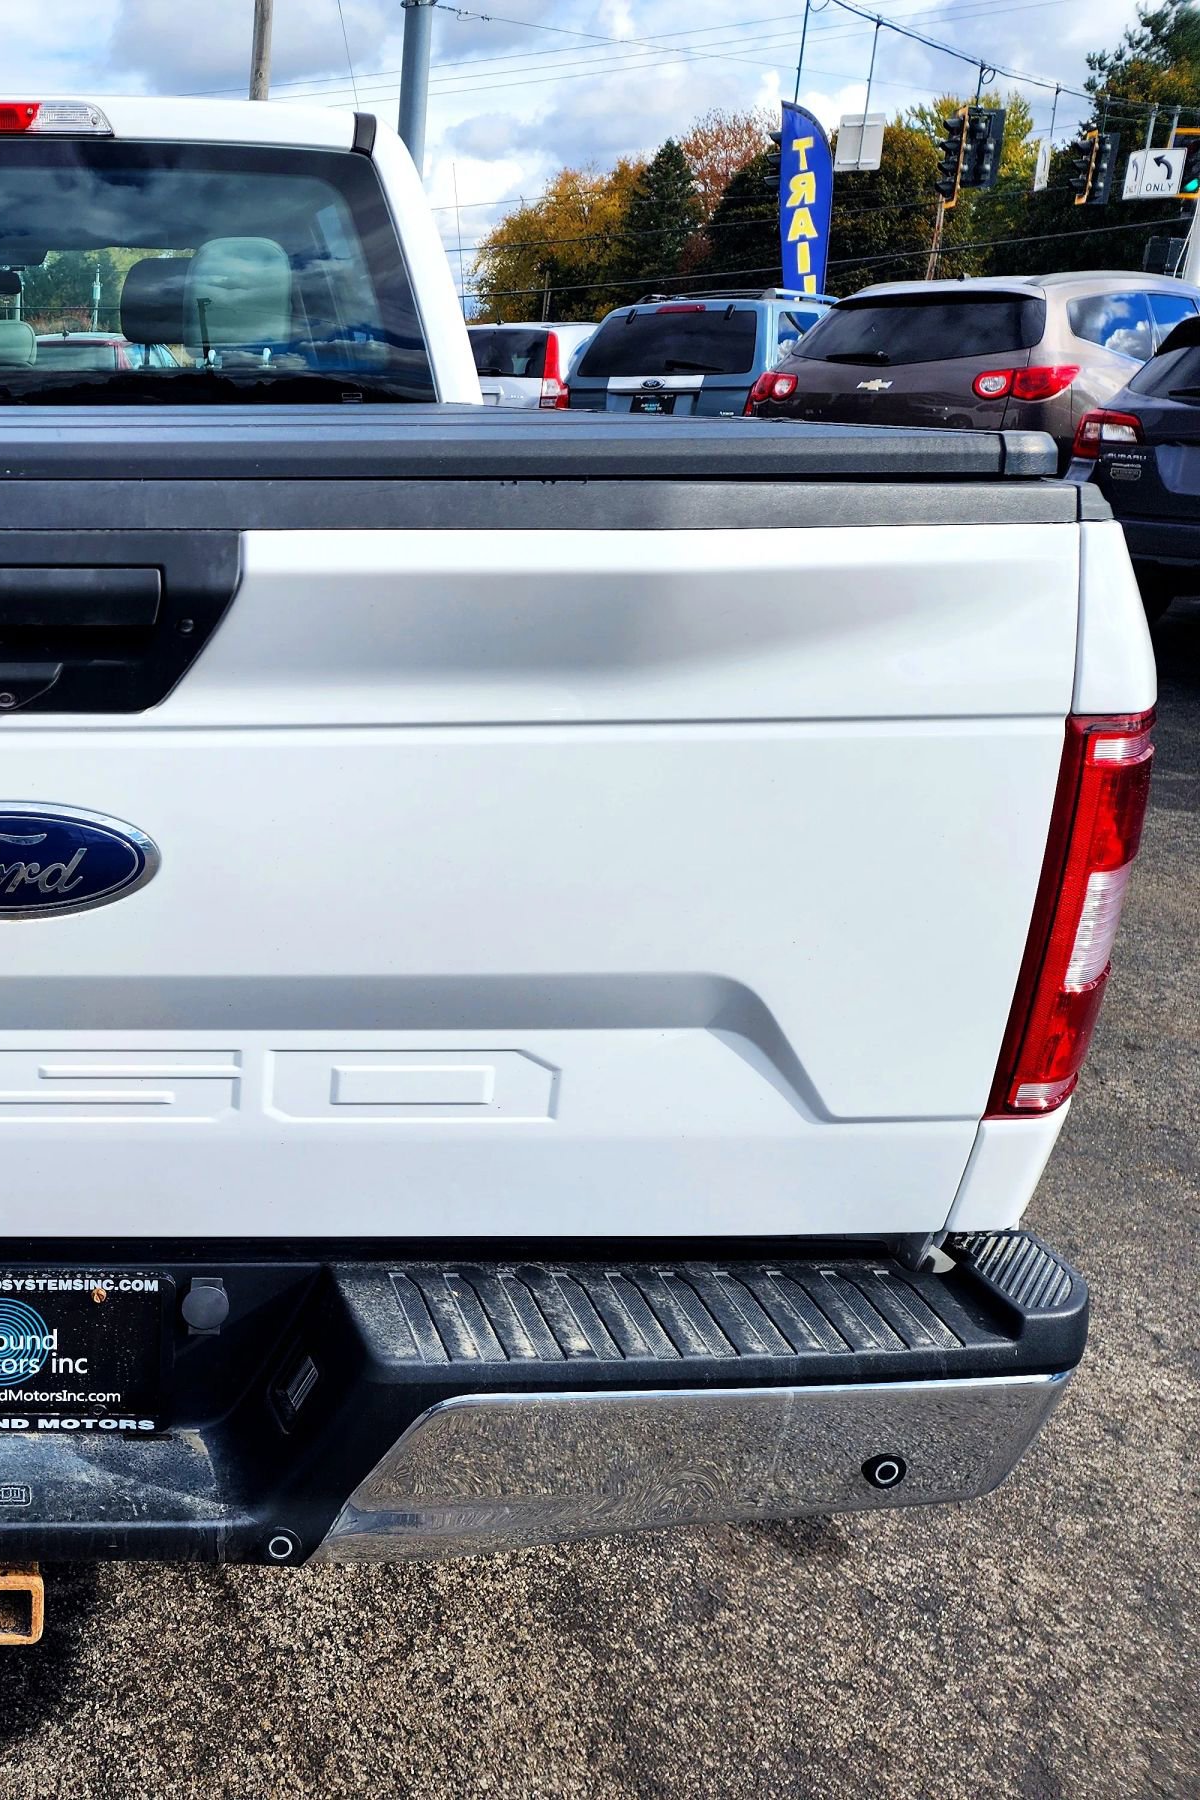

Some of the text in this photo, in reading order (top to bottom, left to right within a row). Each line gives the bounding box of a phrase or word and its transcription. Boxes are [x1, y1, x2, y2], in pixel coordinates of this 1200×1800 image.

[1145, 182, 1174, 192] ONLY
[51, 1352, 88, 1374] inc
[37, 1417, 156, 1430] MOTORS
